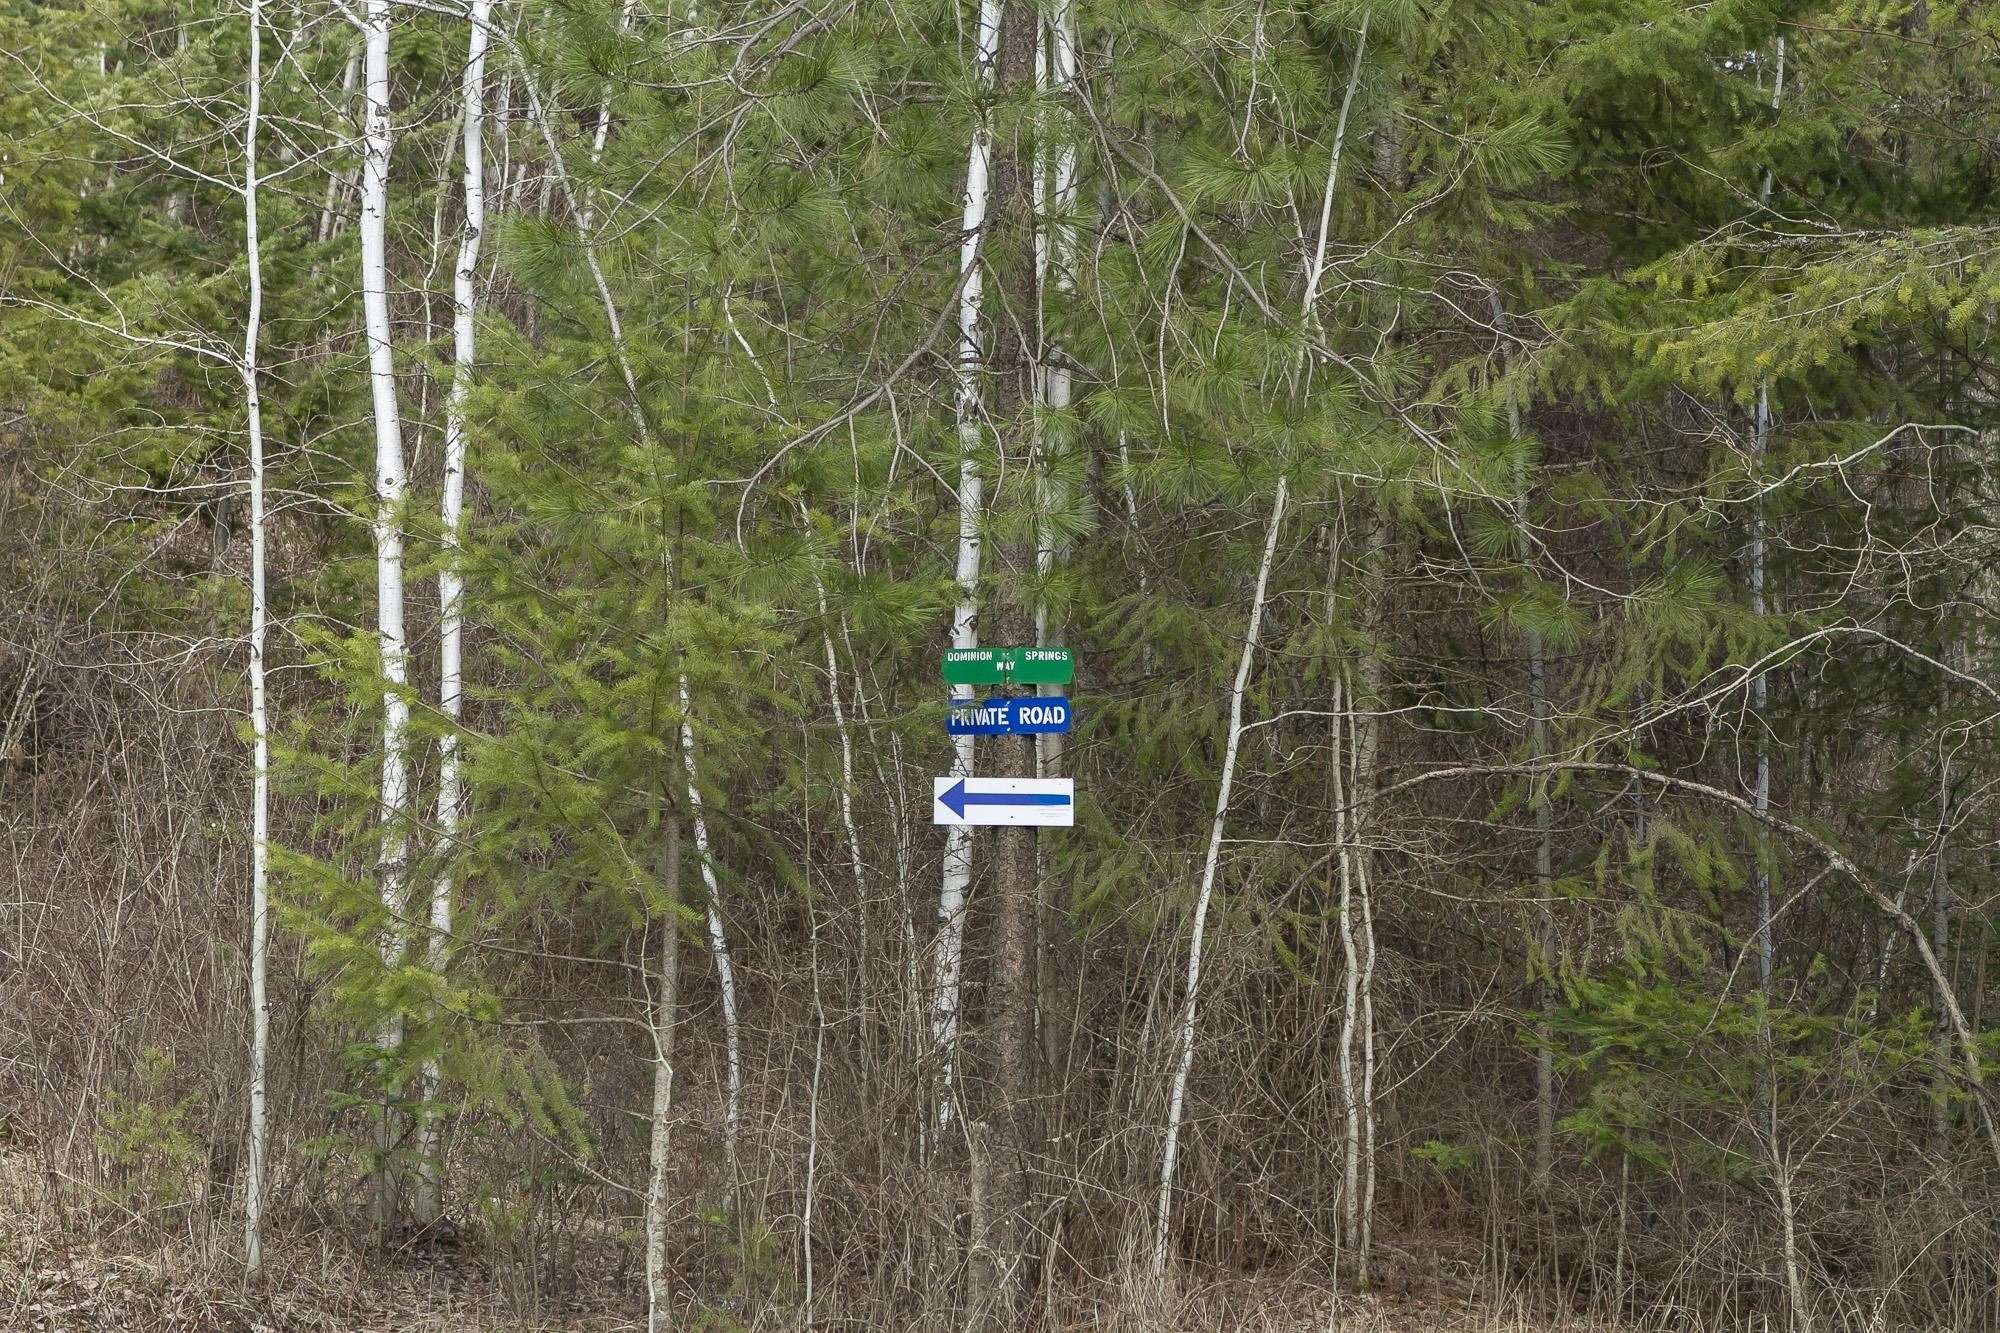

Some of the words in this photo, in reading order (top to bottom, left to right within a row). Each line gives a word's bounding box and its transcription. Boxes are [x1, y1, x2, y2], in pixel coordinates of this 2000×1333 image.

[947, 652, 993, 661] DOMINION
[1025, 651, 1068, 660] SPRINGS
[996, 661, 1015, 670] WAY
[951, 707, 1009, 726] PRIVATE
[1019, 706, 1065, 725] ROAD
